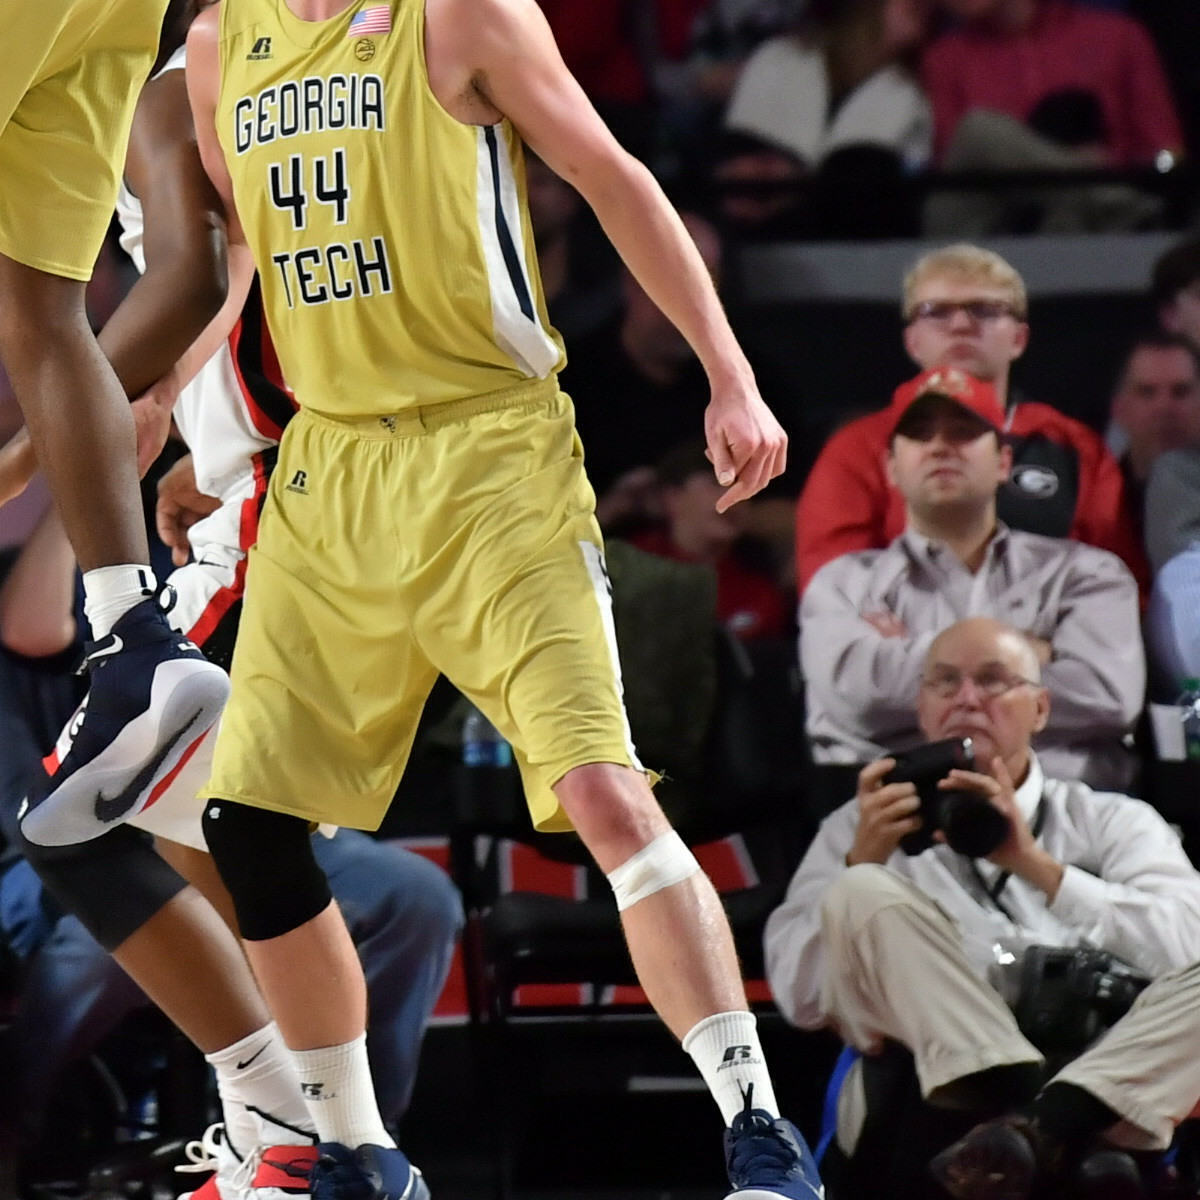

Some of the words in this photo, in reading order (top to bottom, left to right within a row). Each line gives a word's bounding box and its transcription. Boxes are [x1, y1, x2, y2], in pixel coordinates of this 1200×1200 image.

[235, 74, 385, 155] GEORGIA
[269, 149, 350, 230] 44
[272, 236, 393, 309] TECH
